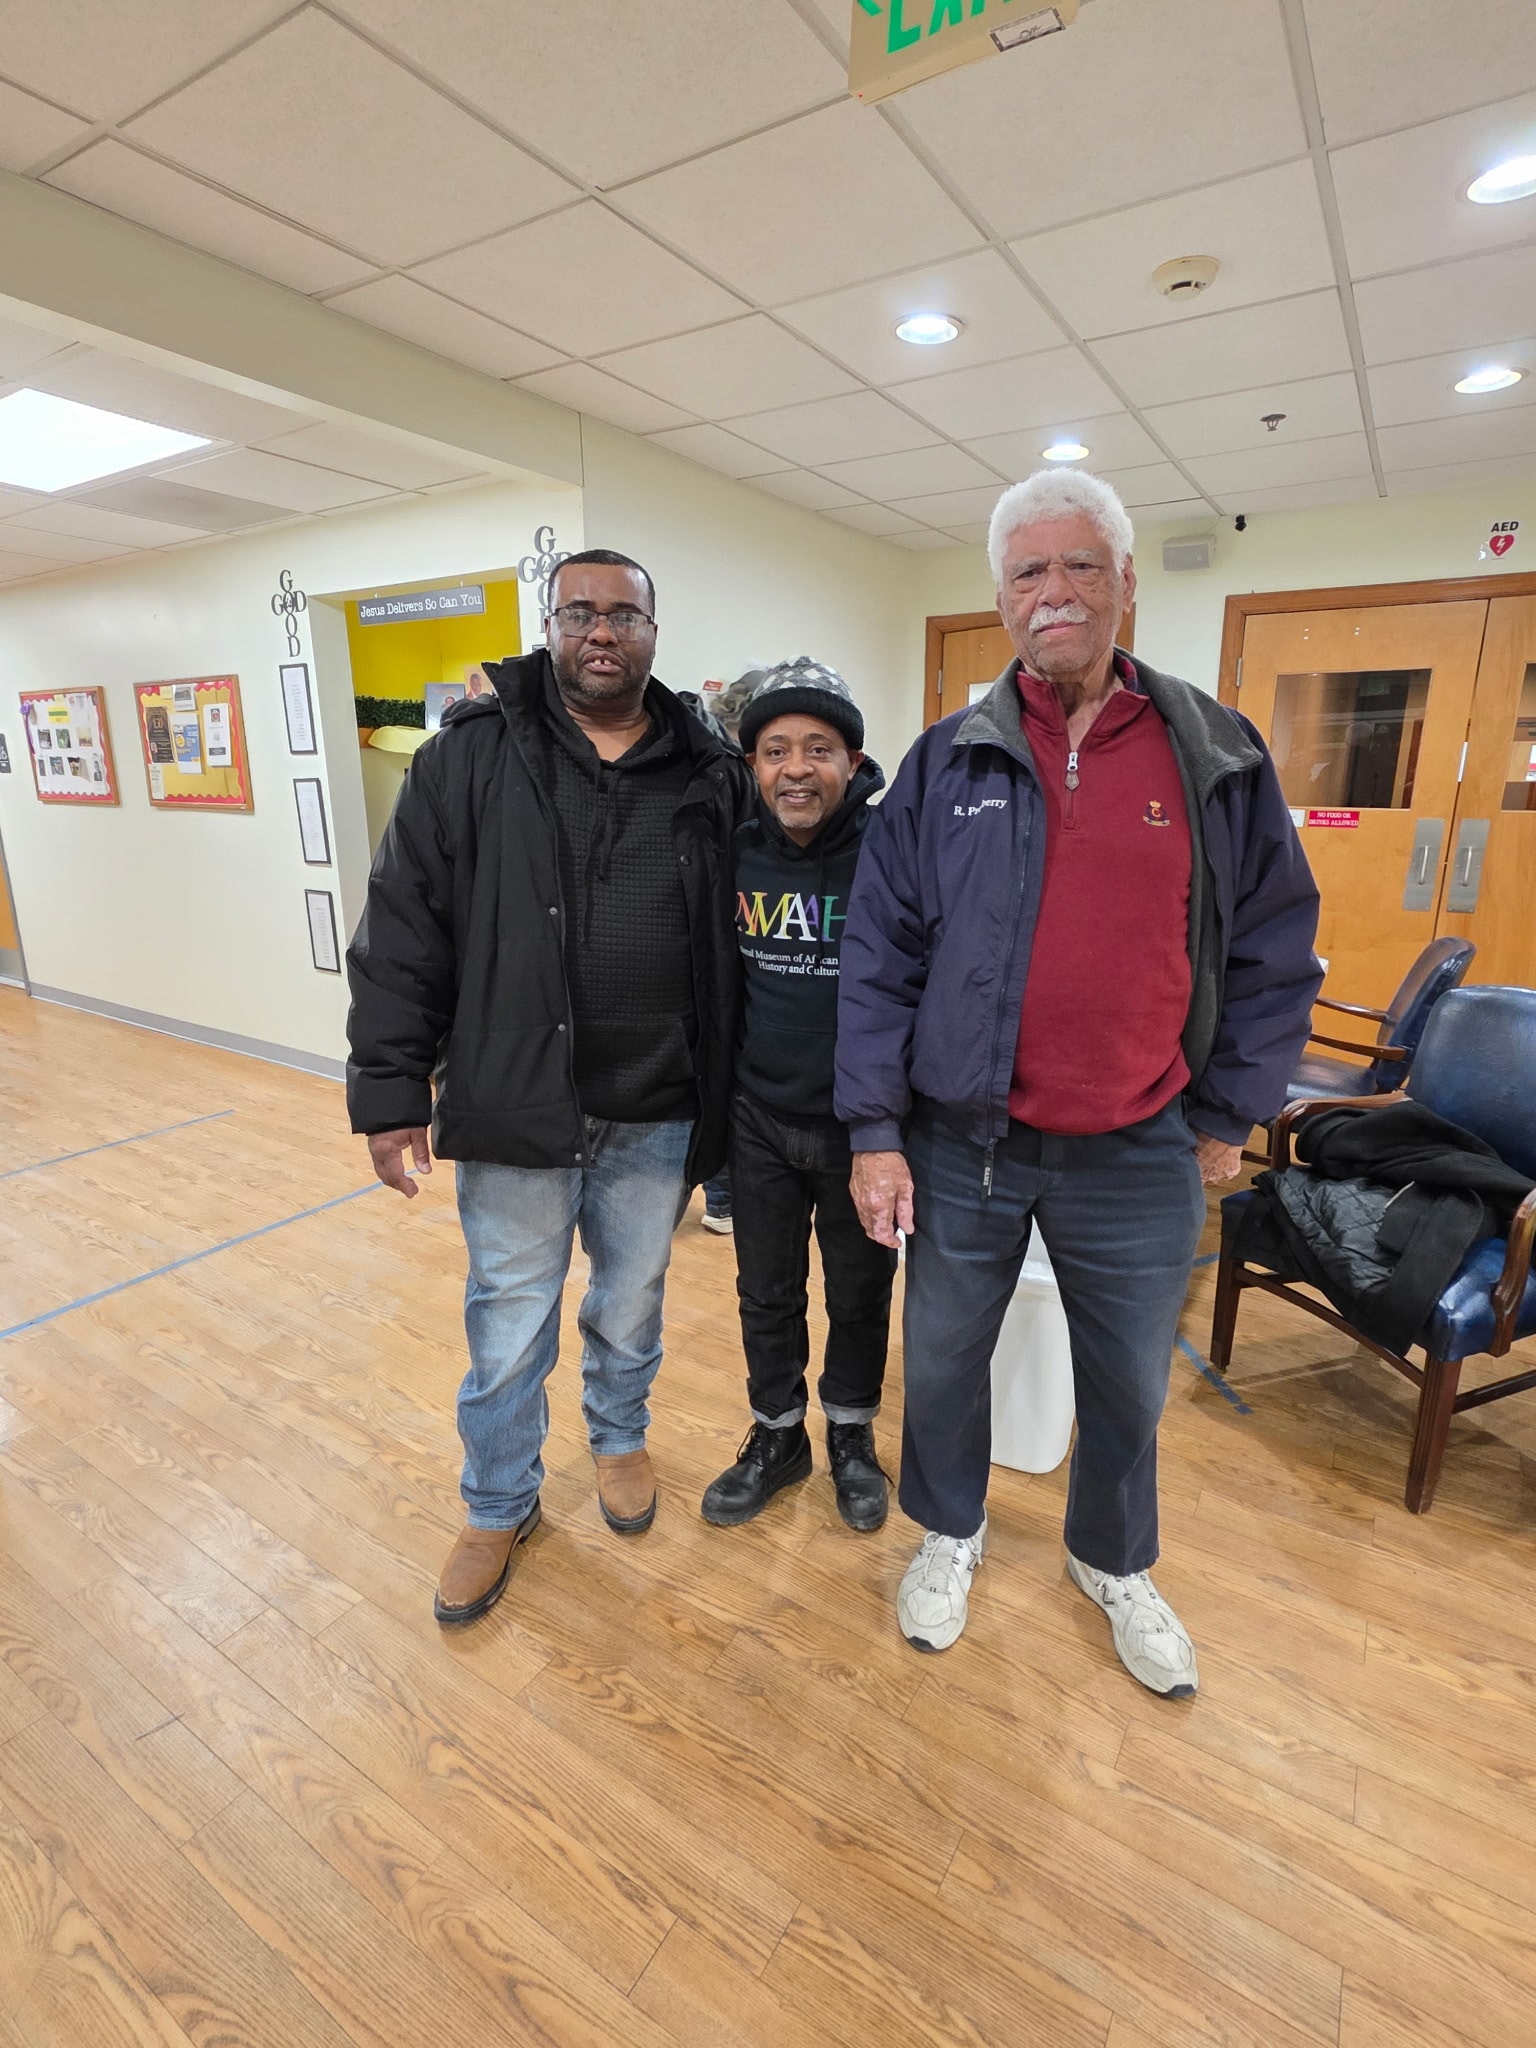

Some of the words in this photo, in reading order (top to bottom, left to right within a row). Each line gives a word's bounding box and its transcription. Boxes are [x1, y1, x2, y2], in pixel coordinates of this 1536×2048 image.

[1490, 521, 1519, 533] AED
[360, 605, 386, 617] Jesus
[386, 601, 423, 615] Delivers
[425, 598, 437, 610] So
[439, 596, 458, 608] Can
[459, 594, 482, 605] You
[953, 805, 965, 816] R.
[1330, 819, 1359, 827] ALLOWED
[755, 950, 792, 962] Museum
[792, 953, 804, 963] of
[804, 954, 839, 965] Afcan
[758, 960, 788, 975] History
[788, 964, 805, 974] and
